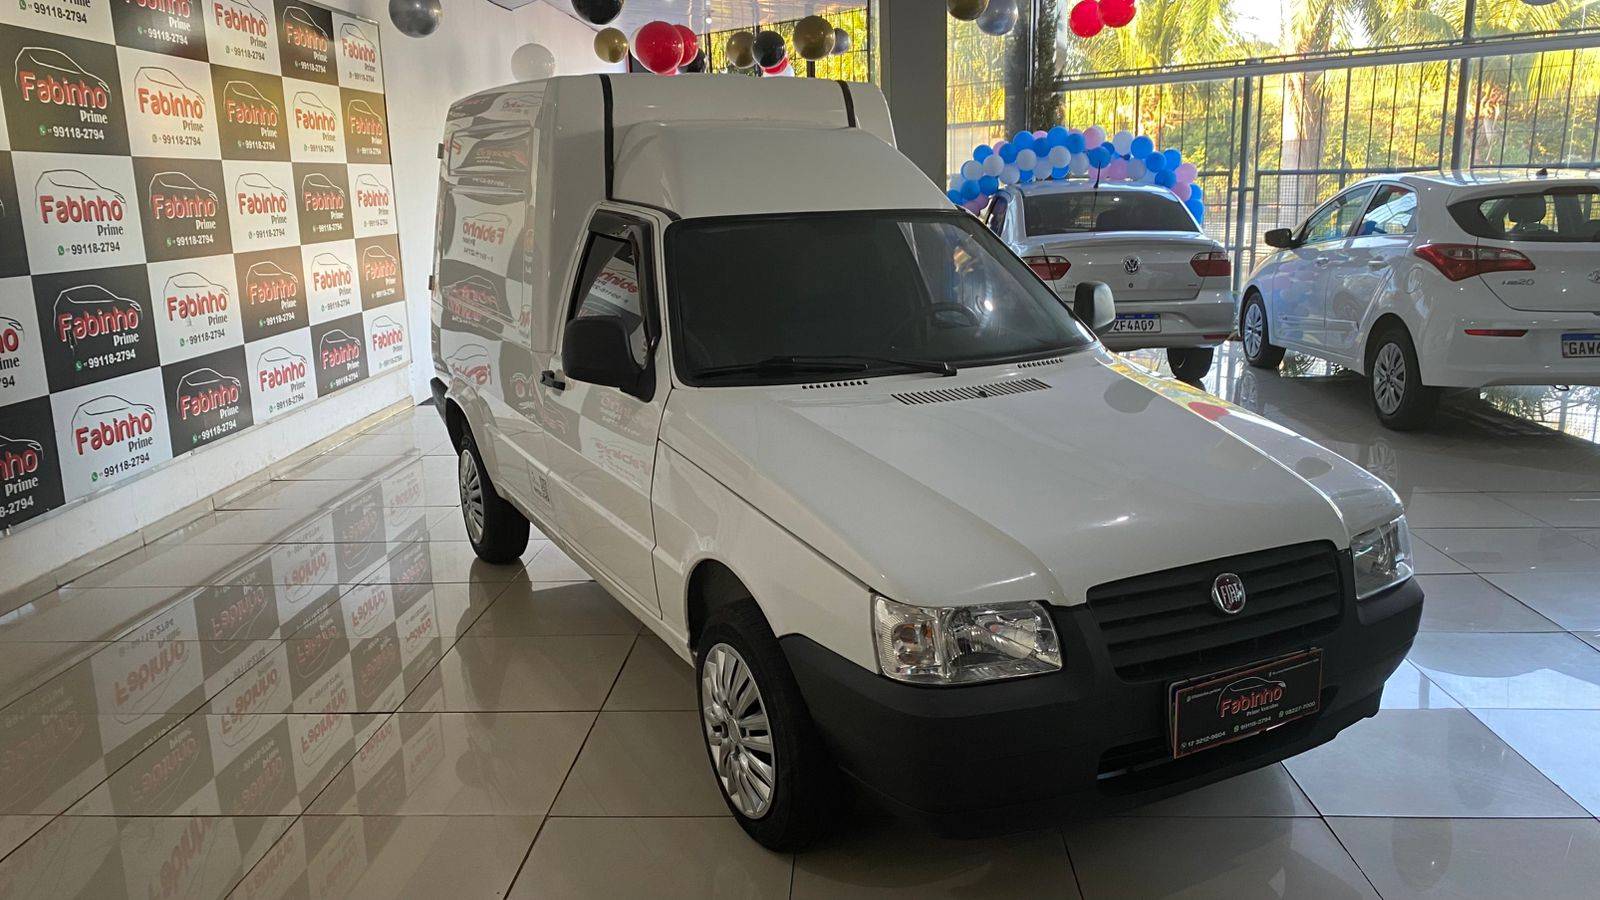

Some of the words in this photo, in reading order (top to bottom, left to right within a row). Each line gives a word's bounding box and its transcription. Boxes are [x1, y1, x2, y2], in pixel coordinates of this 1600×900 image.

[34, 3, 88, 23] 99118-2794
[215, 3, 266, 36] Fabinho
[169, 16, 191, 30] Prime
[147, 28, 188, 44] 99118-2794
[250, 36, 267, 48] Prime
[286, 23, 327, 51] Fabinho
[233, 47, 265, 60] 99118-2794
[342, 39, 375, 63] Fabinho
[20, 71, 107, 108] Fabinho
[138, 87, 202, 118] Fabinho
[80, 109, 108, 123] Prime
[227, 99, 276, 125] Fabinho
[296, 109, 335, 131] Fabinho
[52, 126, 104, 139] 99118-2794
[182, 119, 203, 130] Prime
[261, 126, 277, 136] Prime
[350, 116, 382, 136] Fabinho
[161, 134, 201, 145] 99118-2794
[244, 140, 275, 149] 99118-2794
[153, 194, 215, 218] Fabinho
[238, 193, 286, 214] Fabinho
[305, 192, 343, 210] Fabinho
[358, 191, 389, 207] Fabinho
[40, 195, 123, 223] Fabinho
[195, 218, 216, 229] Prime
[271, 214, 287, 223] Prime
[97, 223, 124, 235] Prime
[255, 228, 285, 237] 99118-2794
[70, 242, 120, 254] 99118-2794
[175, 234, 213, 245] 99118-2794
[365, 261, 396, 280] Fabinho
[314, 269, 351, 291] Fabinho
[249, 278, 296, 304] Fabinho
[167, 291, 227, 320] Fabinho
[281, 298, 297, 309] Prime
[59, 306, 138, 342] Fabinho
[208, 313, 228, 325] Prime
[266, 312, 295, 325] 99118-2794
[113, 332, 139, 346] Prime
[189, 328, 225, 343] 99118-2794
[372, 329, 402, 351] Fabinho
[0, 357, 20, 371] ime
[88, 349, 136, 368] 99118-2794
[323, 344, 359, 369] Fabinho
[260, 362, 305, 391] Fabinho
[291, 382, 306, 392] Prime
[181, 384, 238, 419] Fabinho
[276, 395, 304, 409] 99118-2794
[220, 406, 239, 418] Prime
[77, 413, 153, 456] Fabinho
[201, 421, 237, 439] 99118-2794
[129, 438, 154, 452] Prime
[105, 454, 151, 477] 99118-2794
[5, 477, 38, 496] Prime
[1220, 582, 1242, 605] FIAT
[1221, 687, 1283, 718] Fabinho
